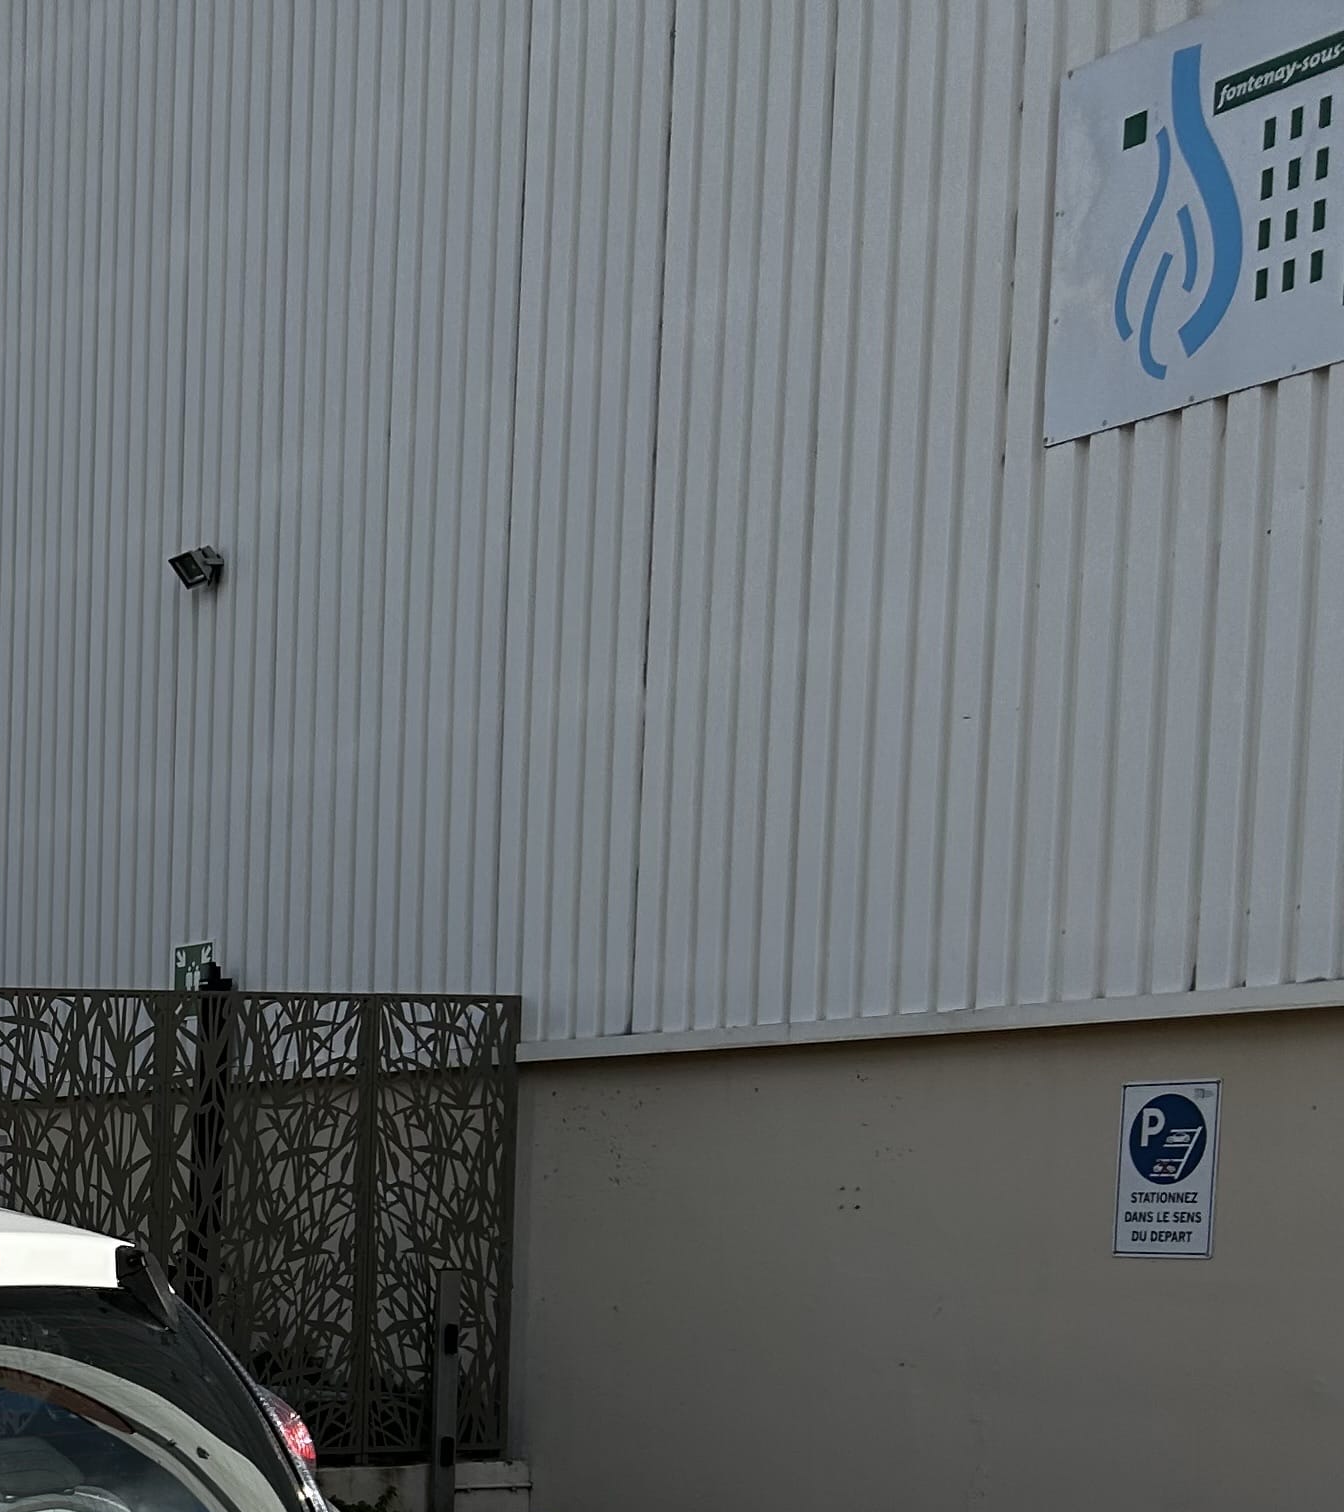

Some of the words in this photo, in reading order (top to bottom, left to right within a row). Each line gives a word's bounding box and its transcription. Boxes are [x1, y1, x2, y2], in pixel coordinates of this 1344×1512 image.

[1140, 1107, 1166, 1147] P
[1130, 1191, 1198, 1204] STATIONNEZ
[1124, 1211, 1154, 1223] DANS
[1156, 1211, 1170, 1223] LE
[1172, 1211, 1202, 1224] SENS
[1131, 1230, 1147, 1242] DU
[1150, 1230, 1193, 1243] DEPART
